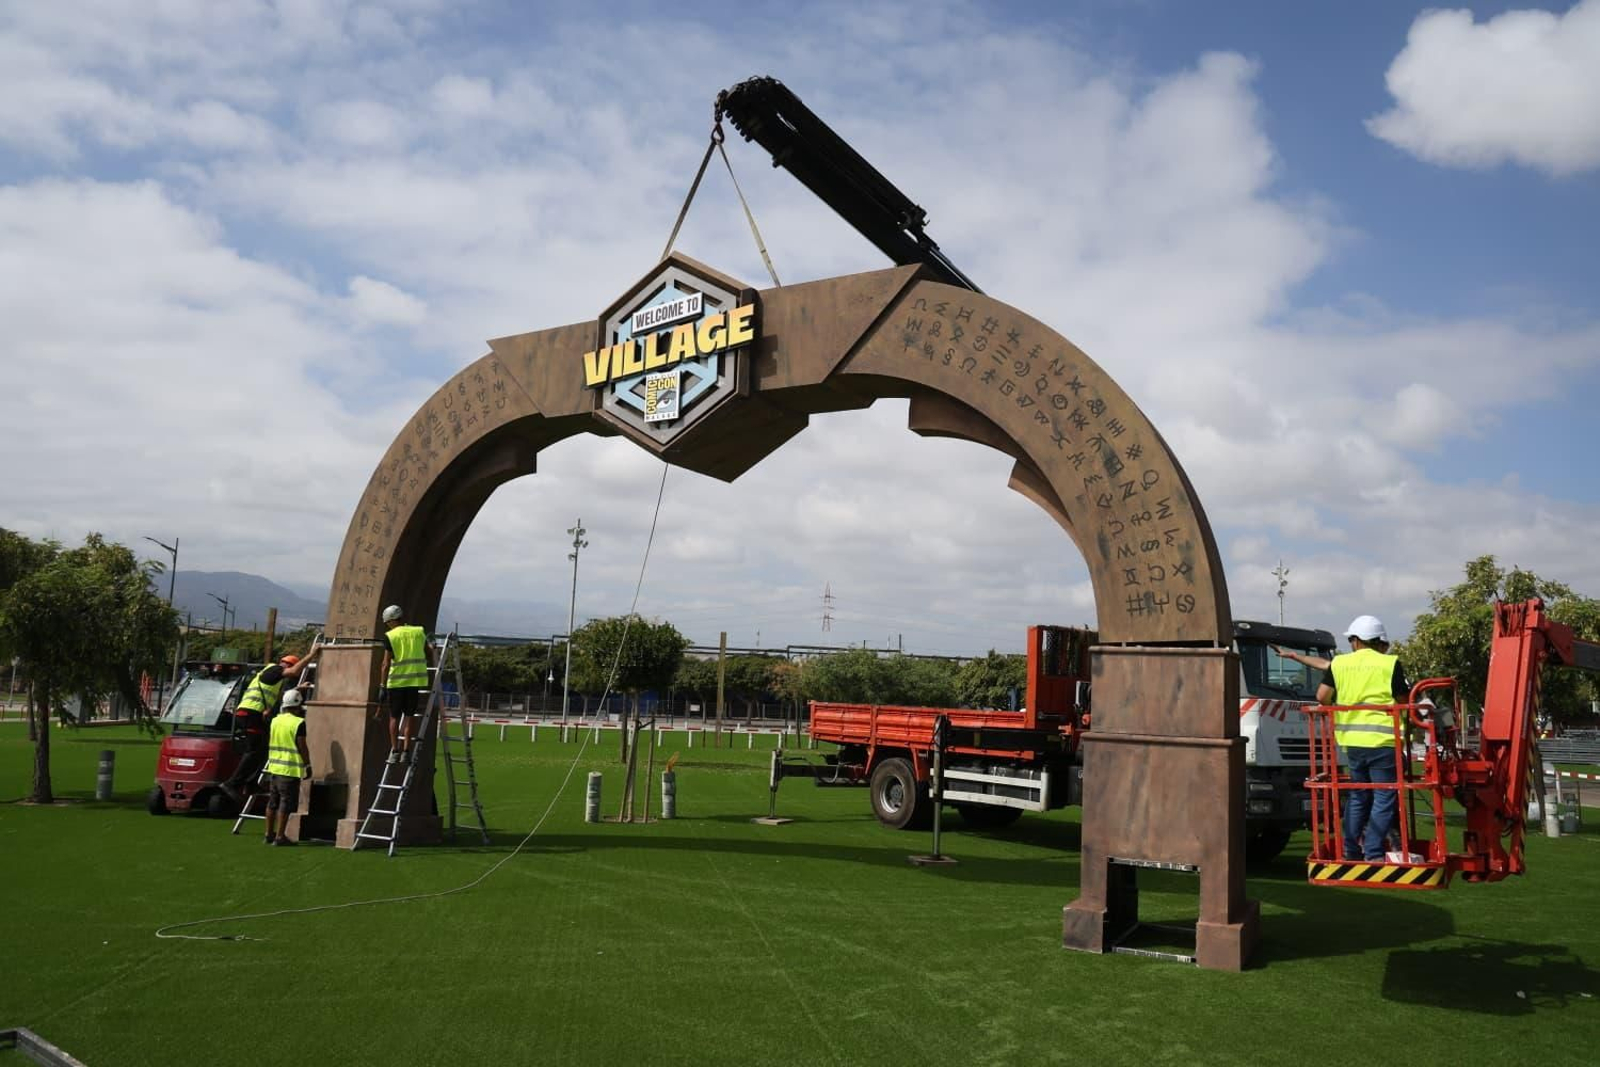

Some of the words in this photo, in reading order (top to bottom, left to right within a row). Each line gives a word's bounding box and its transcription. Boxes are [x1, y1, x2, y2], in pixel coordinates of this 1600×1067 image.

[636, 301, 683, 329] WELCOME
[687, 297, 698, 313] TO
[583, 304, 754, 386] VILLAGE
[647, 380, 657, 415] COMIC
[658, 377, 676, 390] CON
